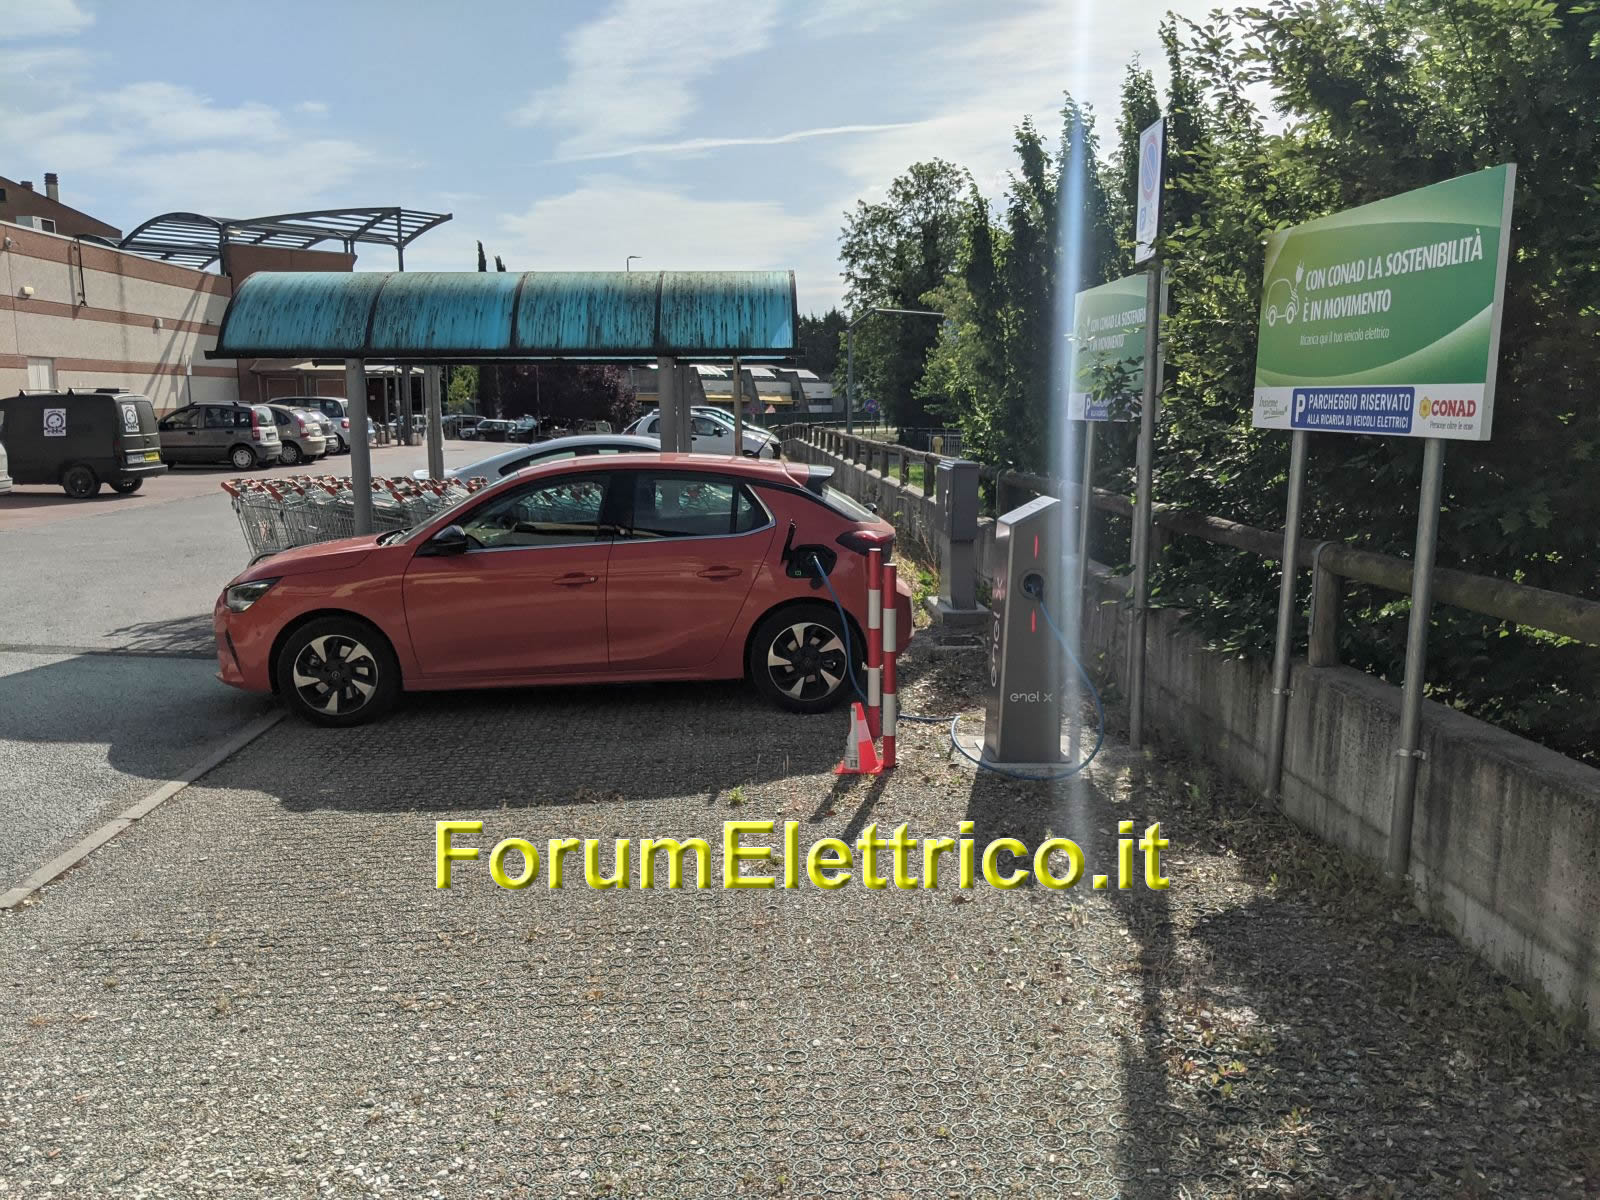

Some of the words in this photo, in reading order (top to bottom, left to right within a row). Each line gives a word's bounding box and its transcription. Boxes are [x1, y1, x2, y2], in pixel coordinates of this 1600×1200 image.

[1305, 267, 1326, 291] CON
[1327, 259, 1365, 287] CONAD
[1367, 255, 1382, 280] LA
[1384, 227, 1483, 277] SOSTENIBILITÀ
[1302, 297, 1310, 322] È
[1310, 300, 1322, 321] IN
[1323, 288, 1391, 319] MOVIMENTO
[1344, 328, 1364, 341] veicolo
[1365, 327, 1390, 340] elettrico
[1295, 394, 1306, 423] P
[1308, 393, 1358, 410] PARCHEGGIO
[1360, 394, 1411, 411] RISERVATO
[1431, 399, 1477, 417] CONAD
[1307, 413, 1320, 425] ALLA
[1321, 414, 1345, 426] RICARICA
[1346, 415, 1353, 427] DI
[1353, 415, 1376, 428] VEICOLI
[1377, 416, 1409, 429] ELETTRICI
[991, 611, 1001, 688] enel
[1009, 691, 1039, 703] enel
[1043, 693, 1053, 703] x
